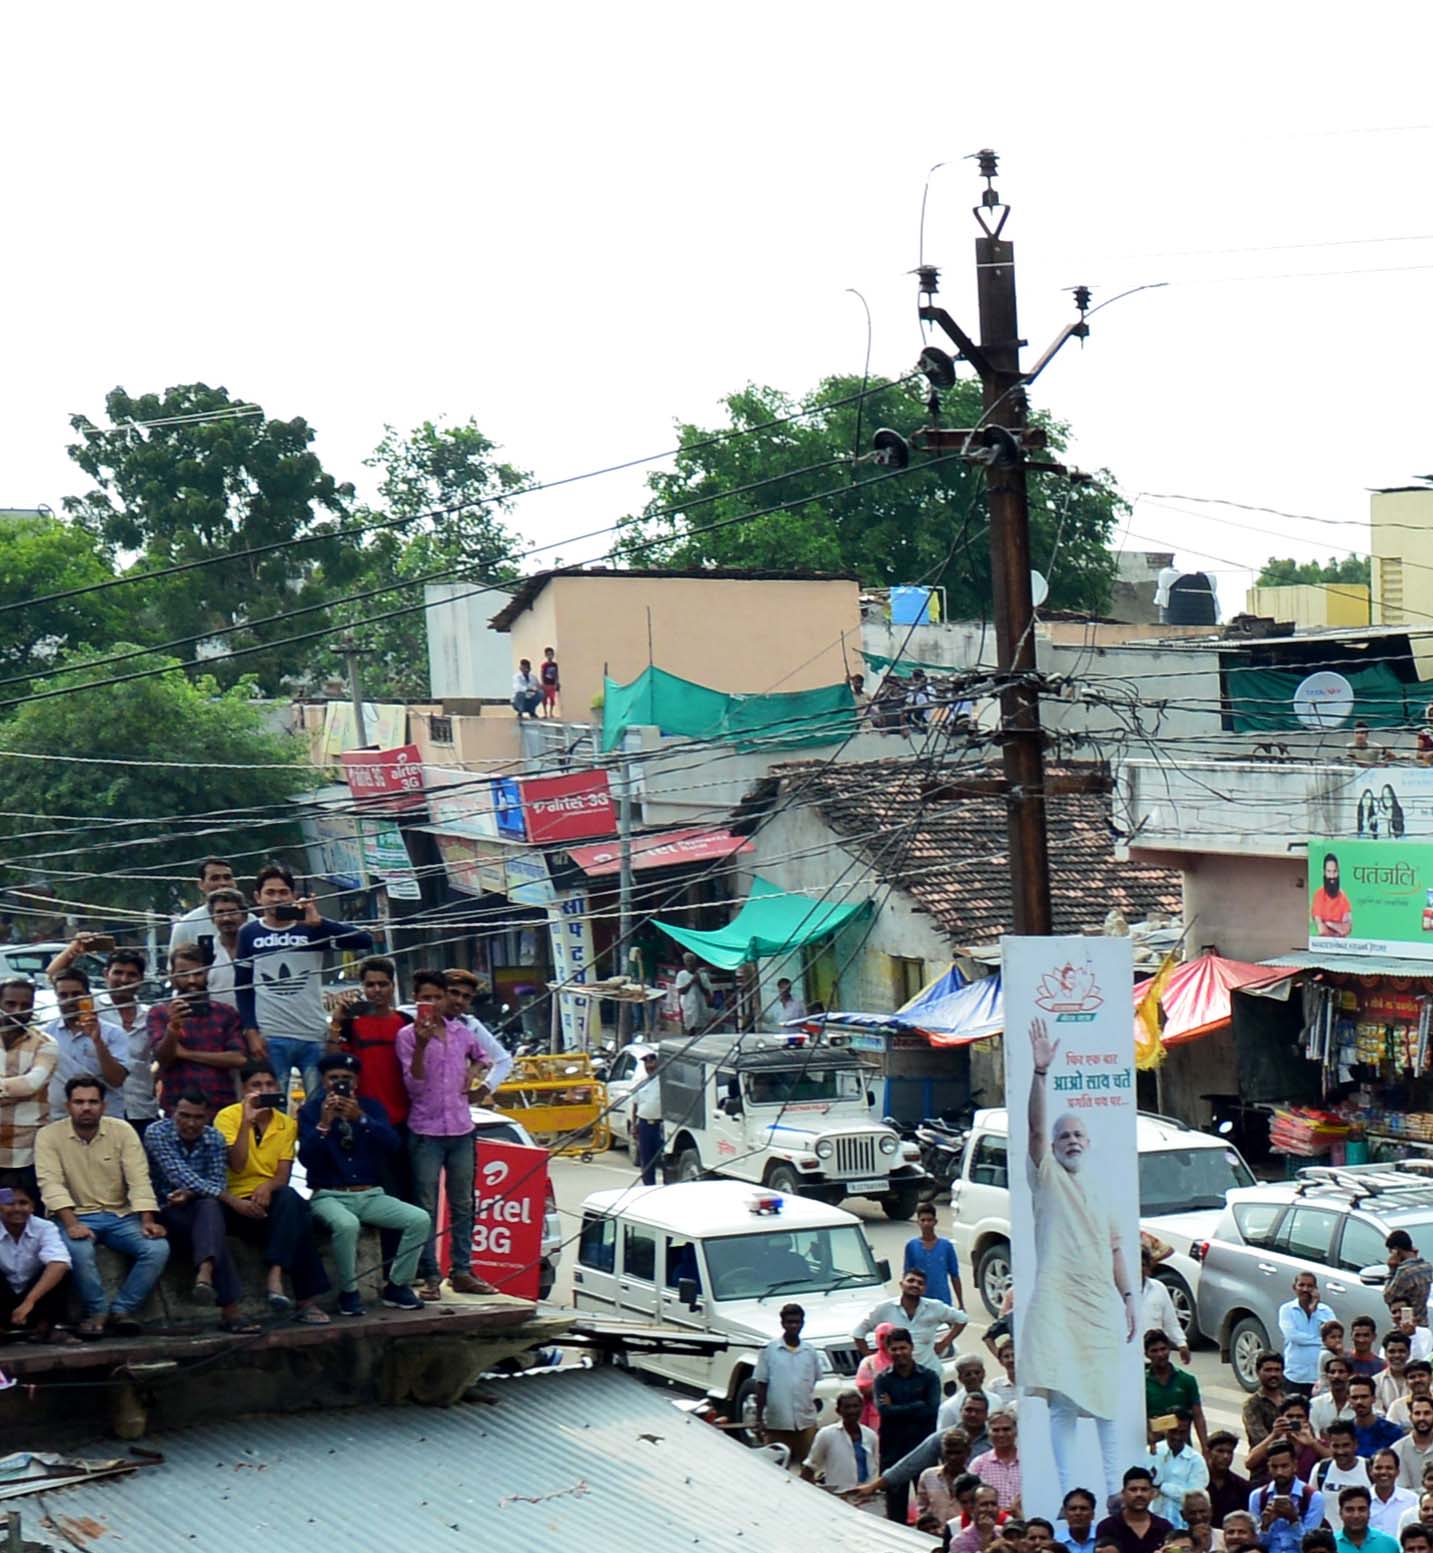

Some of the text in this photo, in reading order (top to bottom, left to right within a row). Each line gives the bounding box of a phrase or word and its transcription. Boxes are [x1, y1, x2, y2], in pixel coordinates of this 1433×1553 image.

[401, 777, 421, 791] 3G
[548, 791, 610, 813] airtel 3G
[1352, 857, 1417, 887] पतंजलि
[253, 934, 310, 950] adidas
[471, 1223, 512, 1255] 3G
